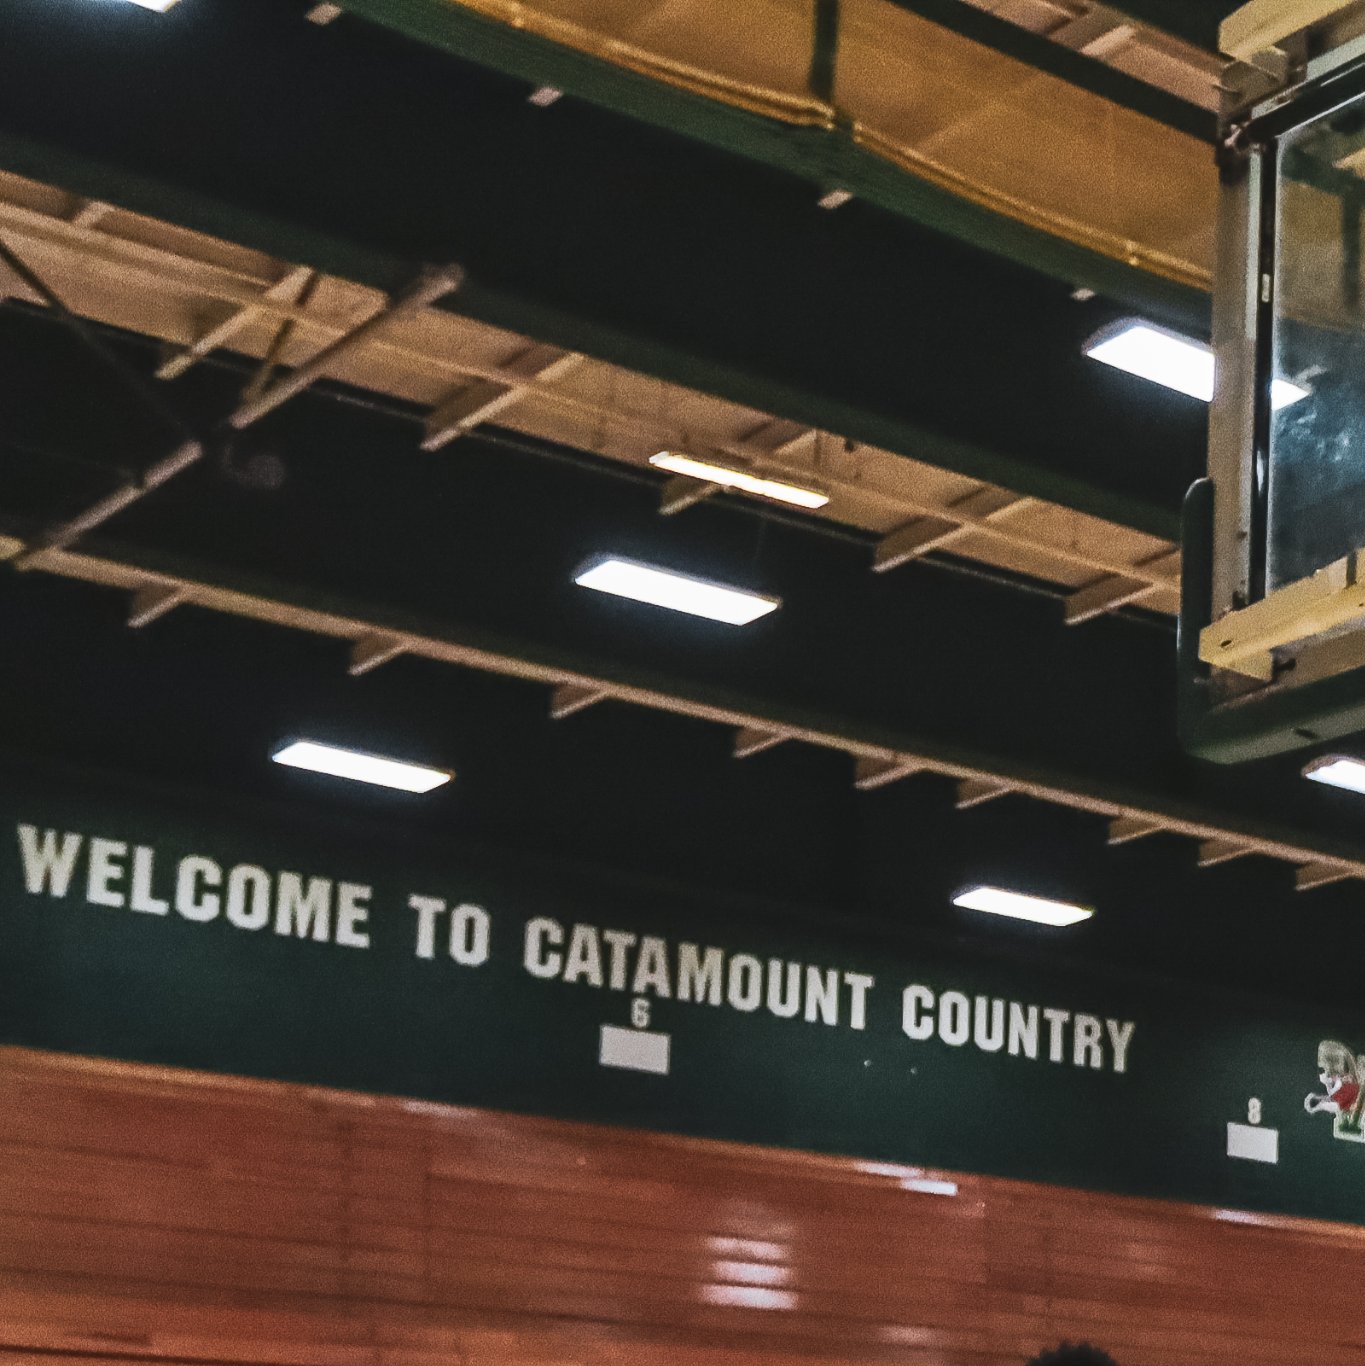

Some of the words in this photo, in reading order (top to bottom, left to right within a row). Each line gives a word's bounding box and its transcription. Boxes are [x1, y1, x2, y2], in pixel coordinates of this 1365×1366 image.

[17, 823, 372, 948] WELCOME
[409, 893, 490, 966] TO
[524, 917, 873, 1030] CATAMOUNT
[902, 984, 1134, 1072] COUNTRY
